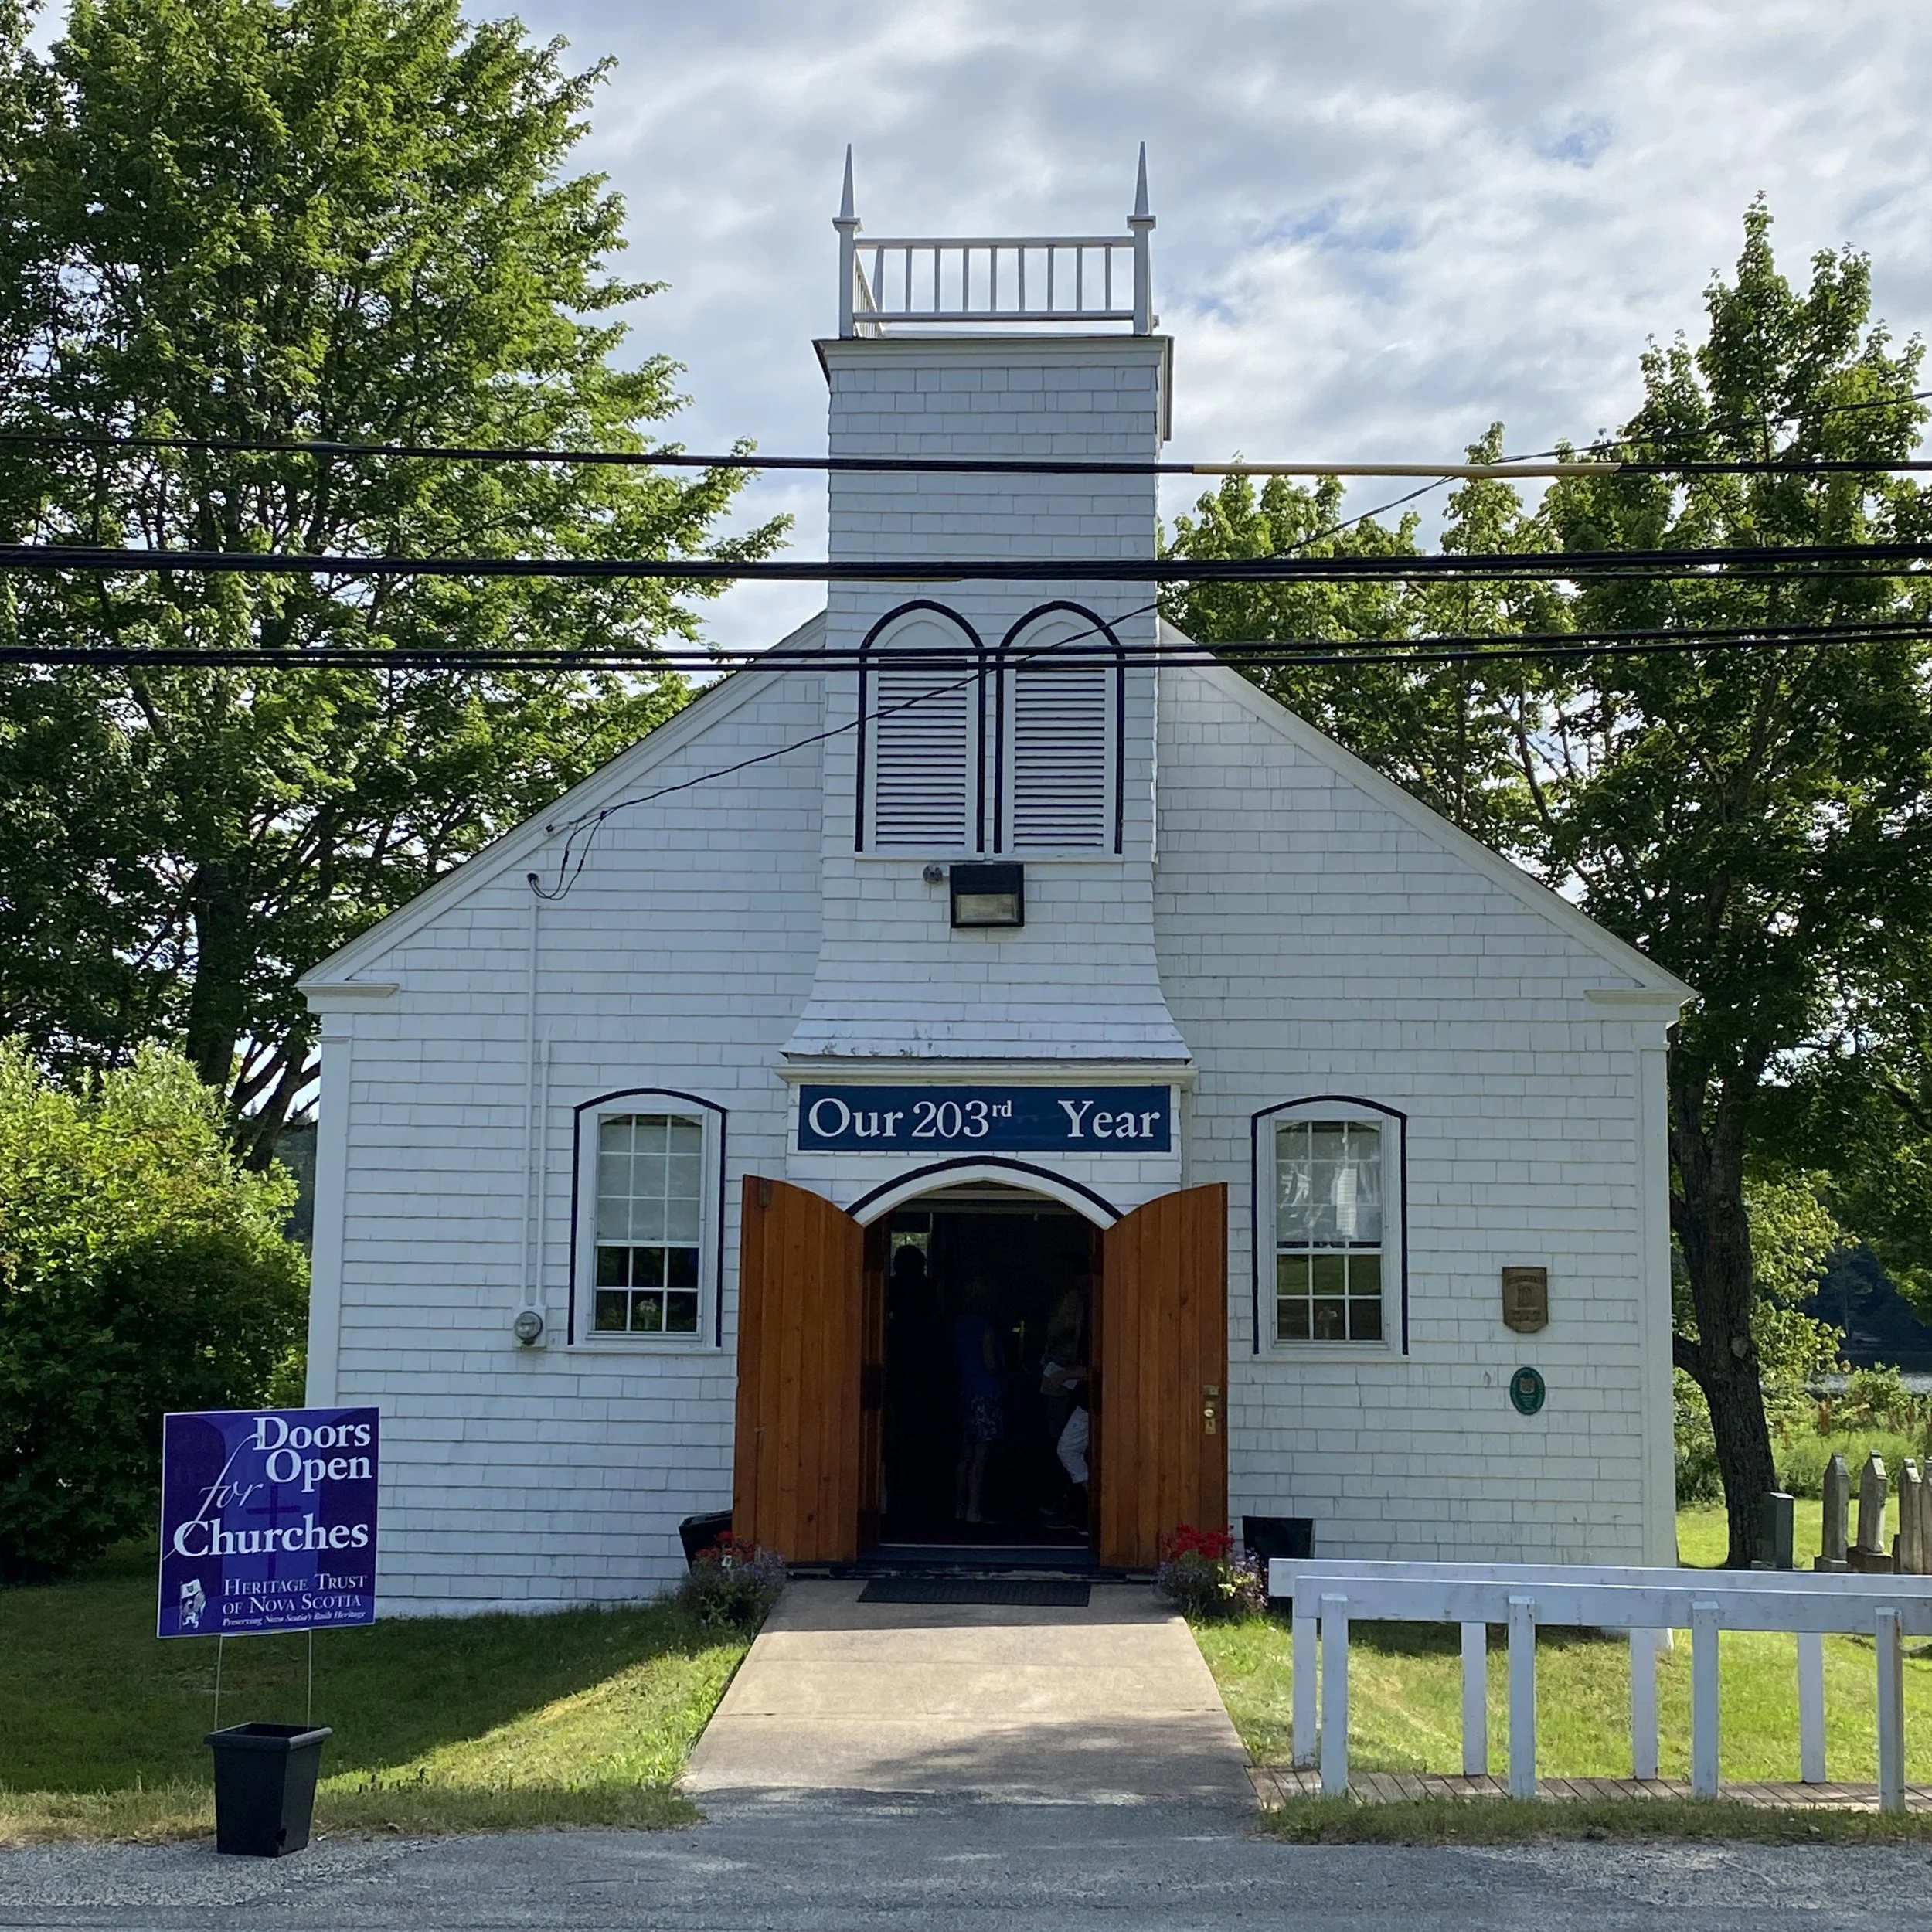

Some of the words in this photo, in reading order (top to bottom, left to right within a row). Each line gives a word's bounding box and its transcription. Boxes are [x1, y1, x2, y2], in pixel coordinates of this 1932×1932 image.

[808, 1097, 904, 1138] Our
[1058, 1100, 1161, 1138] Year
[253, 1416, 371, 1451] Doors
[266, 1448, 372, 1493] Open
[162, 1432, 264, 1561] for
[173, 1513, 369, 1557] Churches
[223, 1578, 309, 1596] HERITAGE
[315, 1573, 368, 1590] TRUST
[249, 1596, 295, 1614] NOVA
[301, 1593, 362, 1610] SCOTIA
